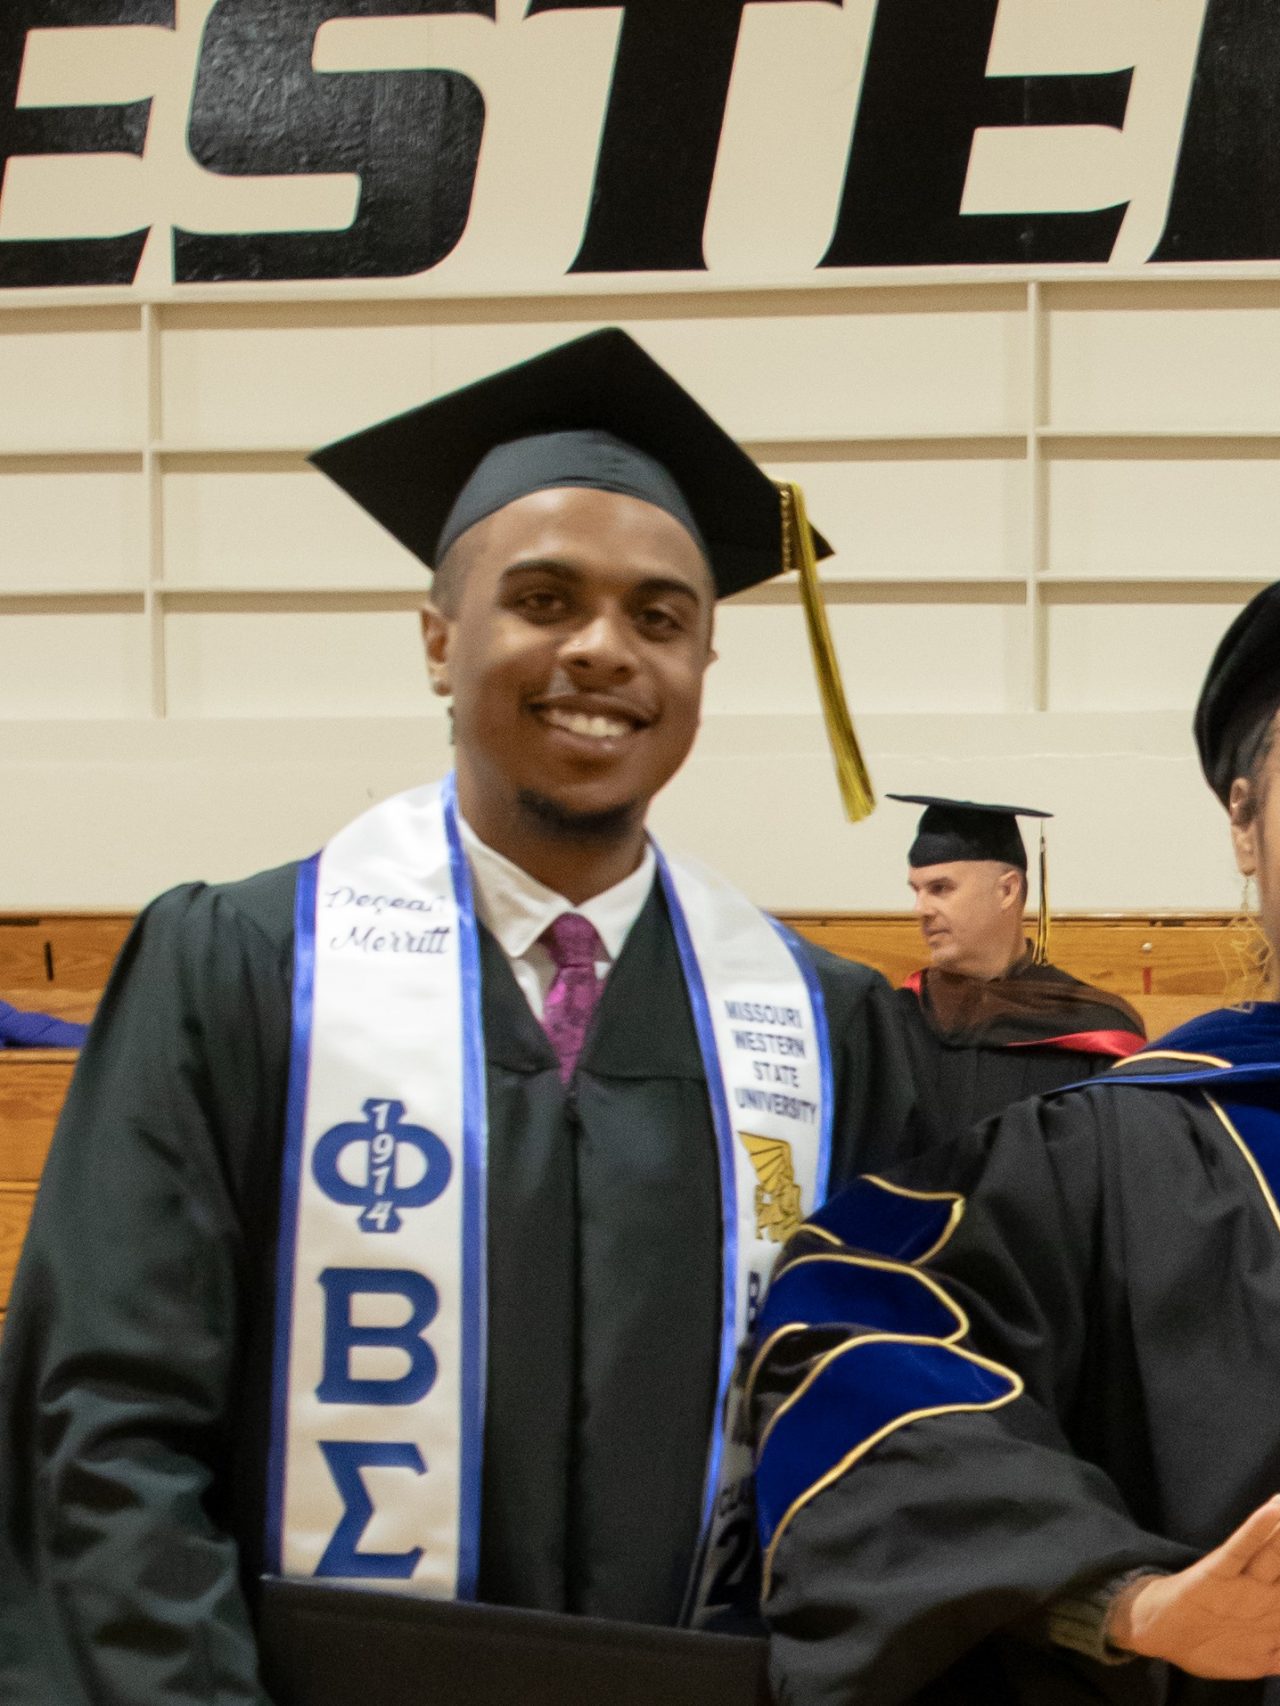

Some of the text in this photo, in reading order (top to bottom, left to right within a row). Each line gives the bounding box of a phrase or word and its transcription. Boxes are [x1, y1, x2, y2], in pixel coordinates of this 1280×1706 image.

[329, 926, 451, 954] Merritt
[724, 999, 803, 1029] MISSOURI
[731, 1029, 806, 1059] WESTERN
[753, 1060, 800, 1088] STATE
[734, 1087, 818, 1124] UNIVERSITY
